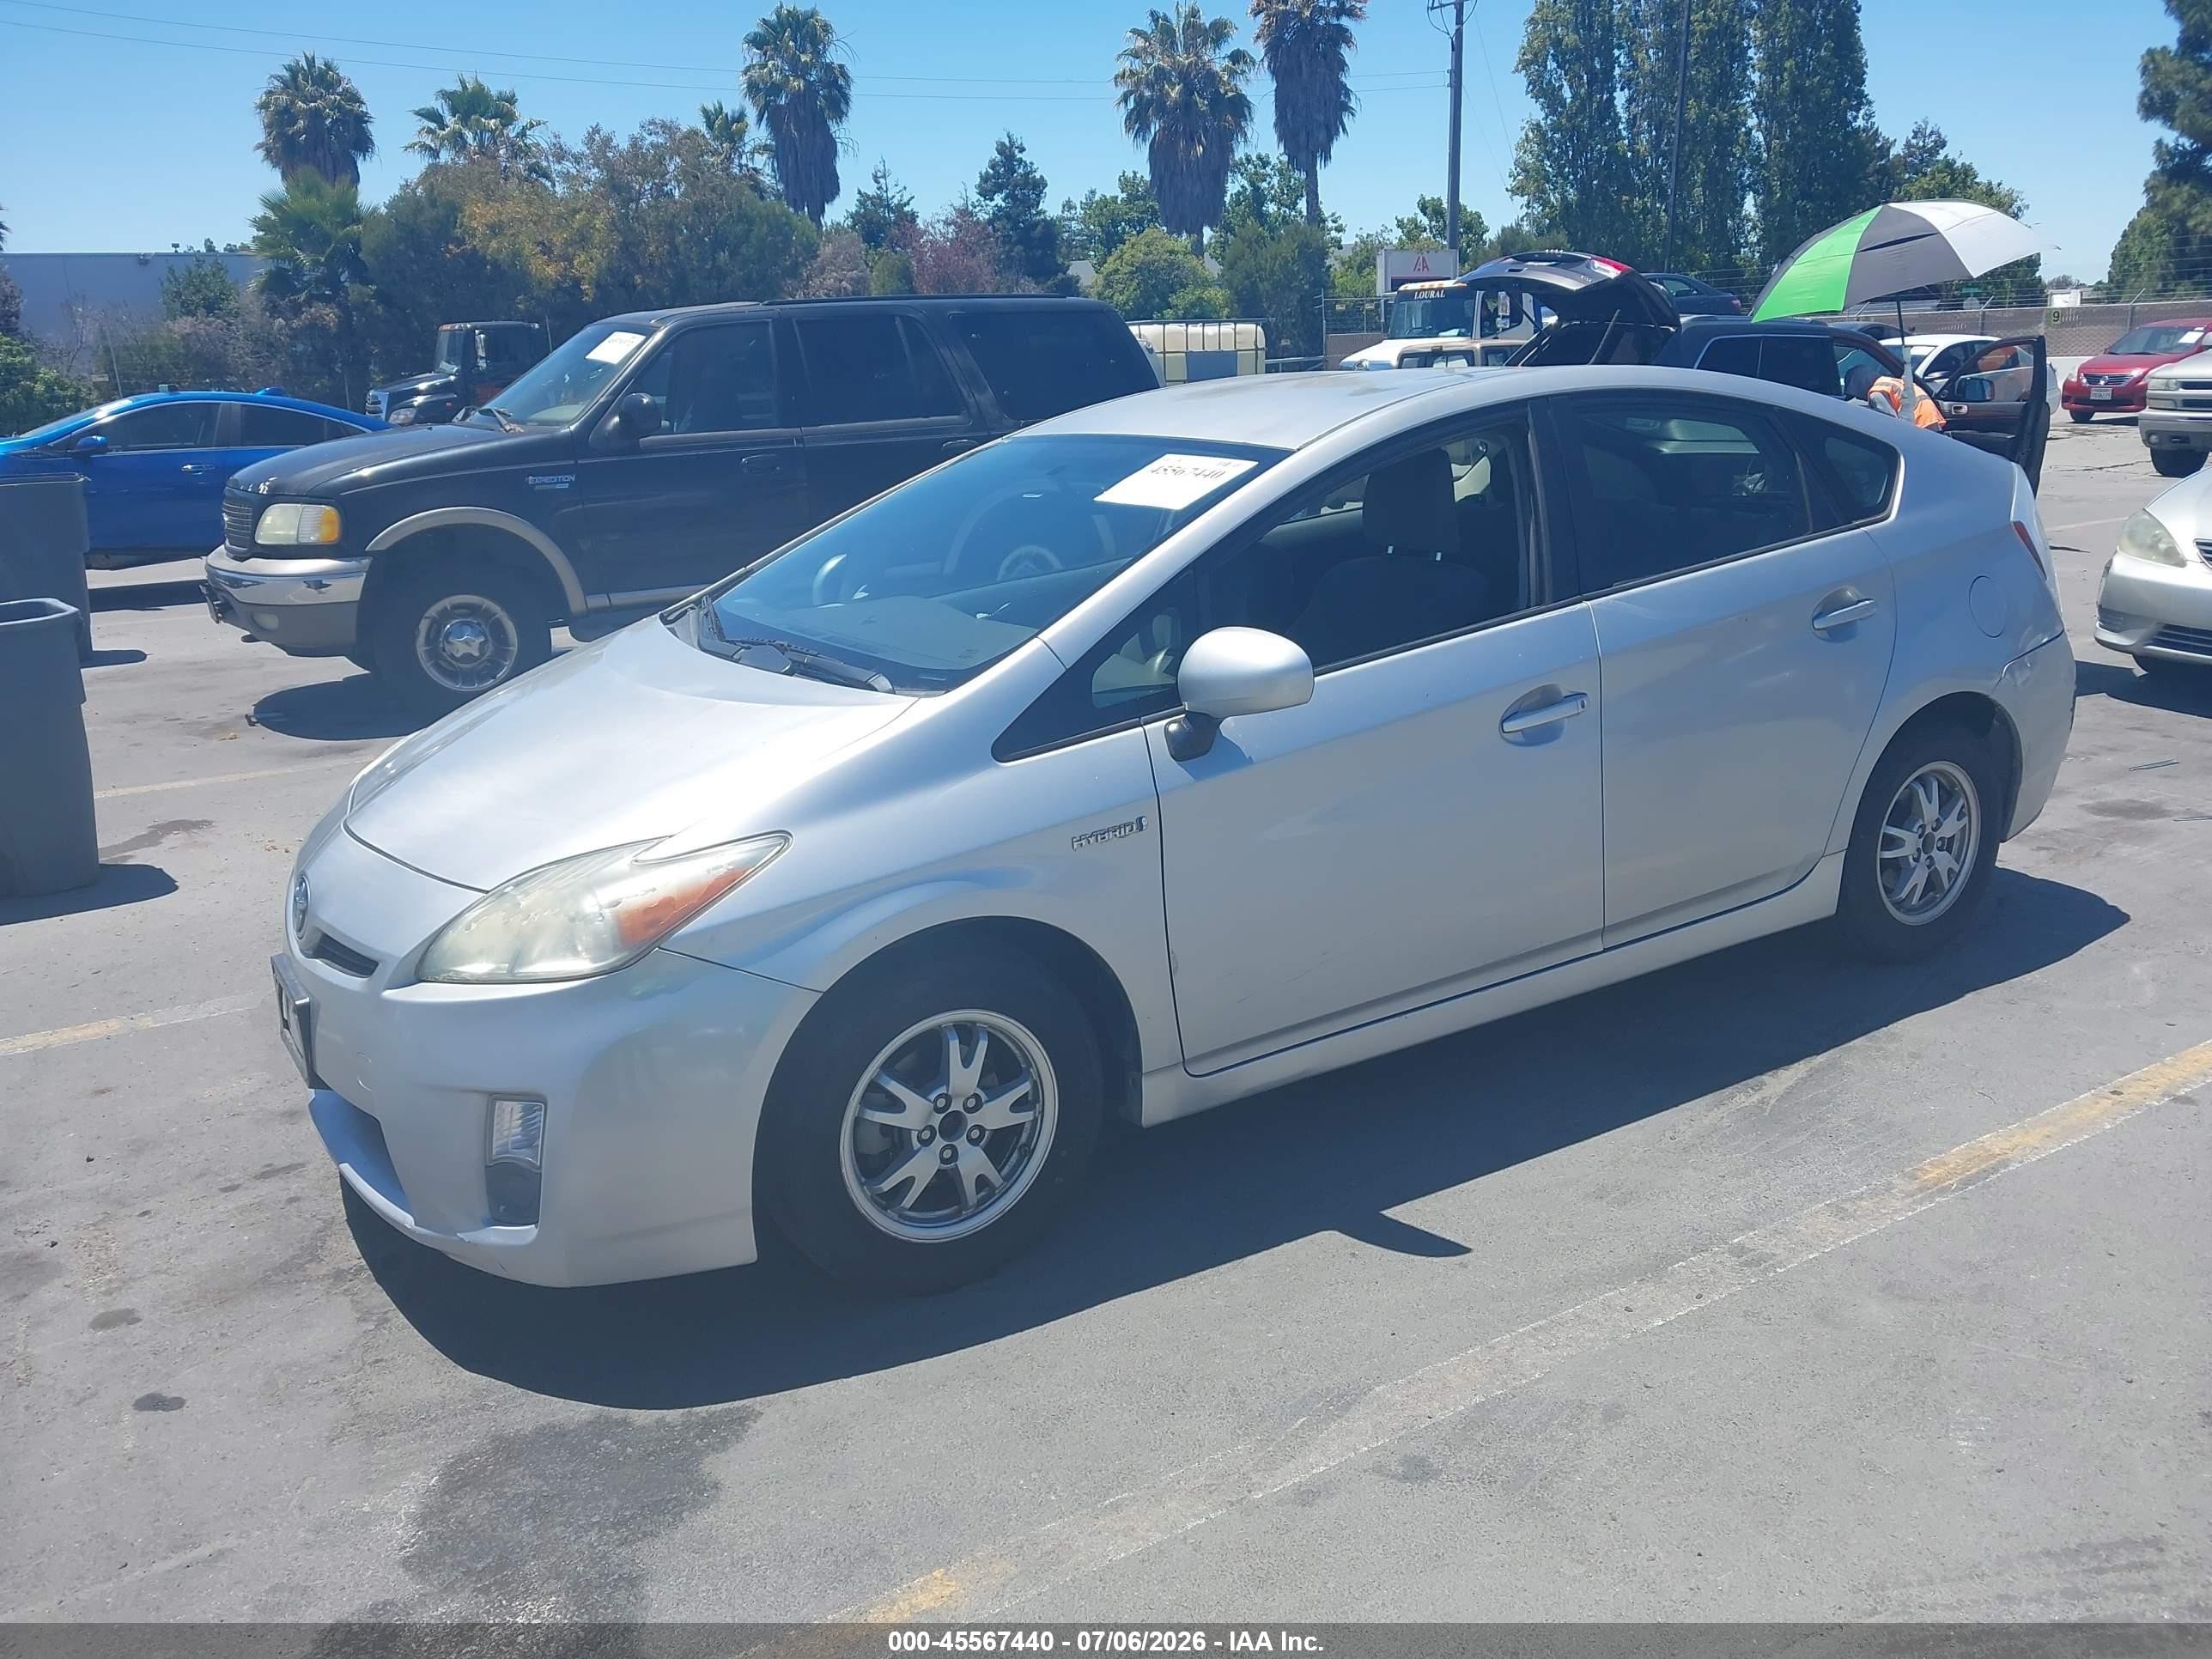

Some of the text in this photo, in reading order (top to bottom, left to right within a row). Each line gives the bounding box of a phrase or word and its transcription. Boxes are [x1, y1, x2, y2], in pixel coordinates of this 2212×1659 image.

[1414, 290, 1446, 300] LOURAL
[2052, 311, 2060, 322] 9
[1072, 821, 1139, 852] HYBRID
